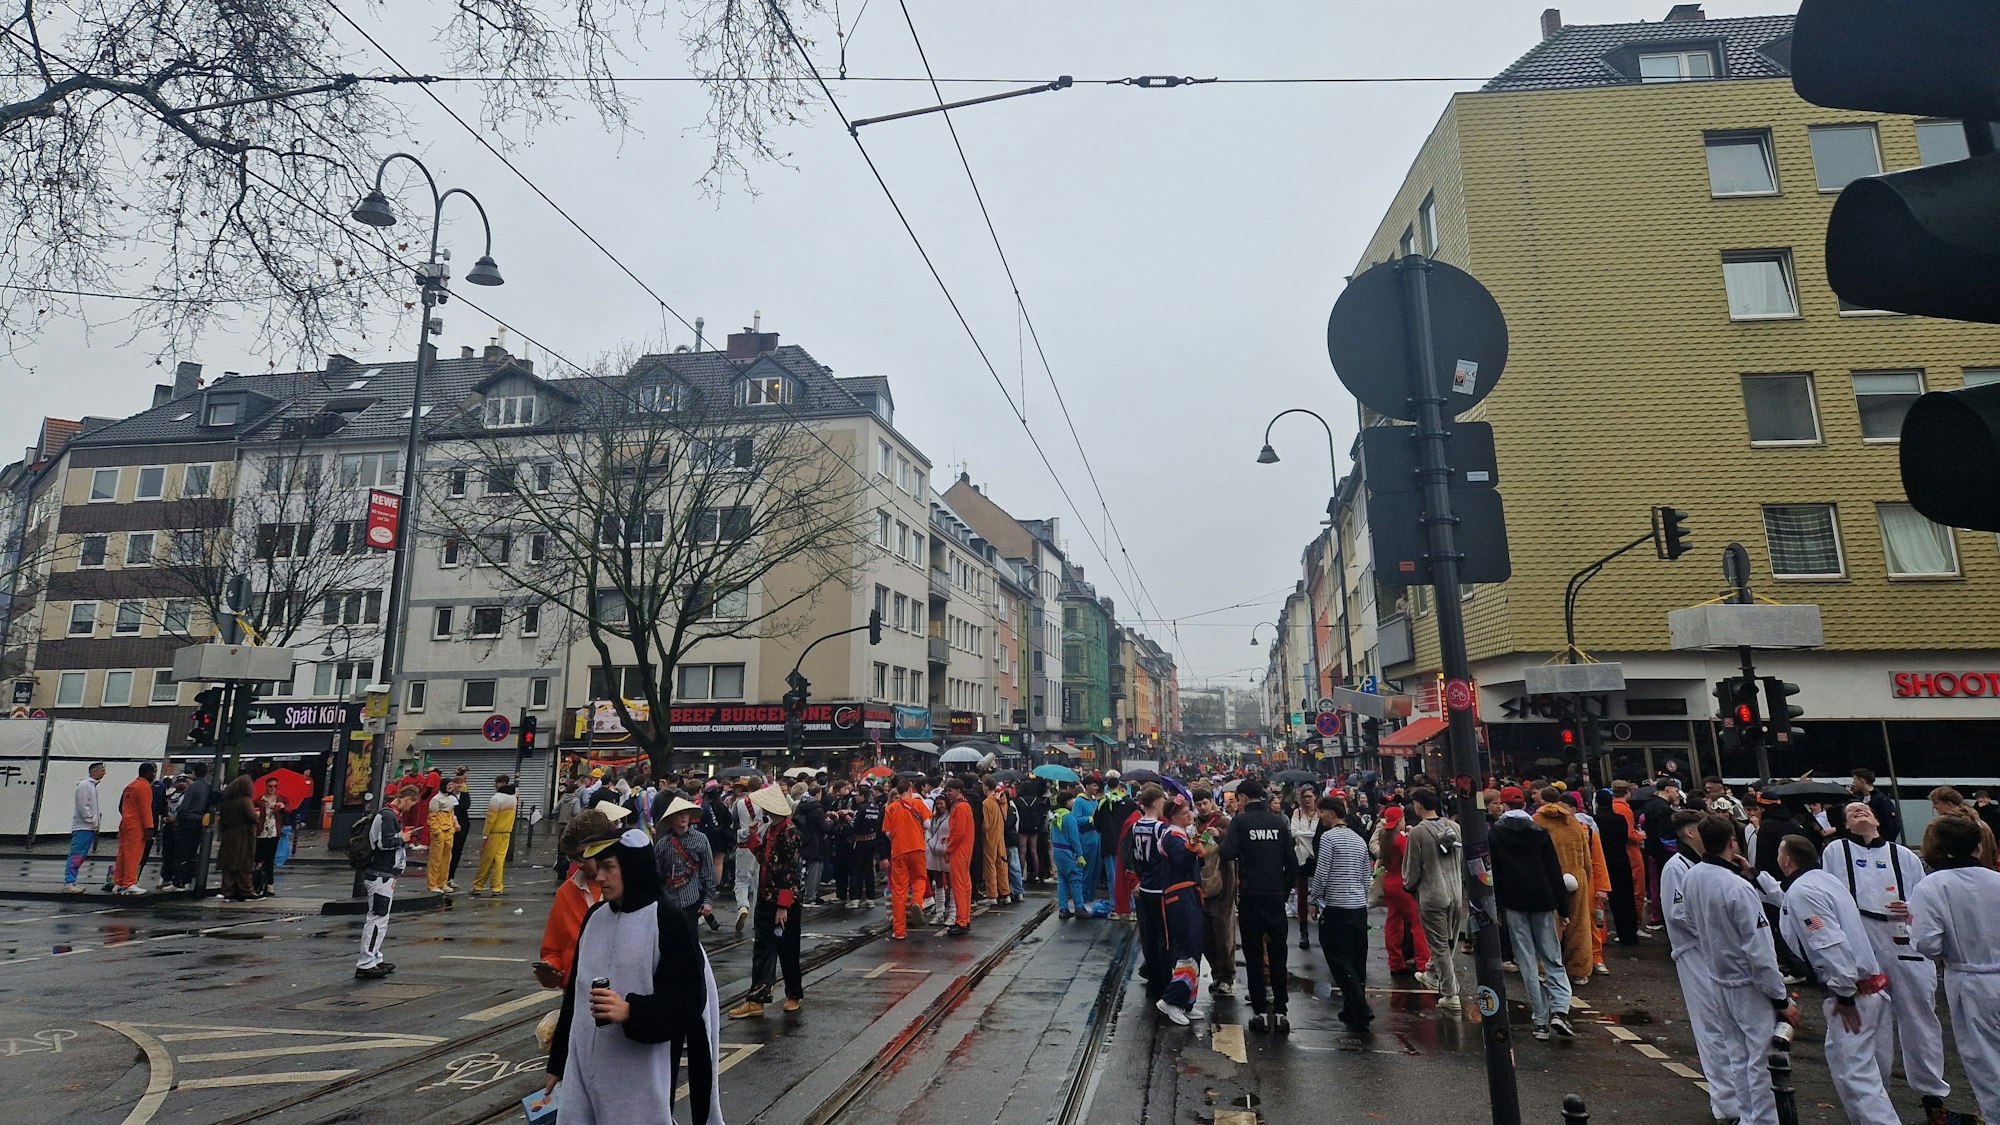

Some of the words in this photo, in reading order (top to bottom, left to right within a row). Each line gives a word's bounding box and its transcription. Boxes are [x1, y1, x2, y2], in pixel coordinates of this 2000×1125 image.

[372, 494, 398, 509] REWE
[284, 705, 318, 729] Späti
[319, 705, 346, 724] Köln
[670, 708, 716, 723] BEEF
[1249, 829, 1279, 840] SWAT
[1134, 834, 1152, 861] 87
